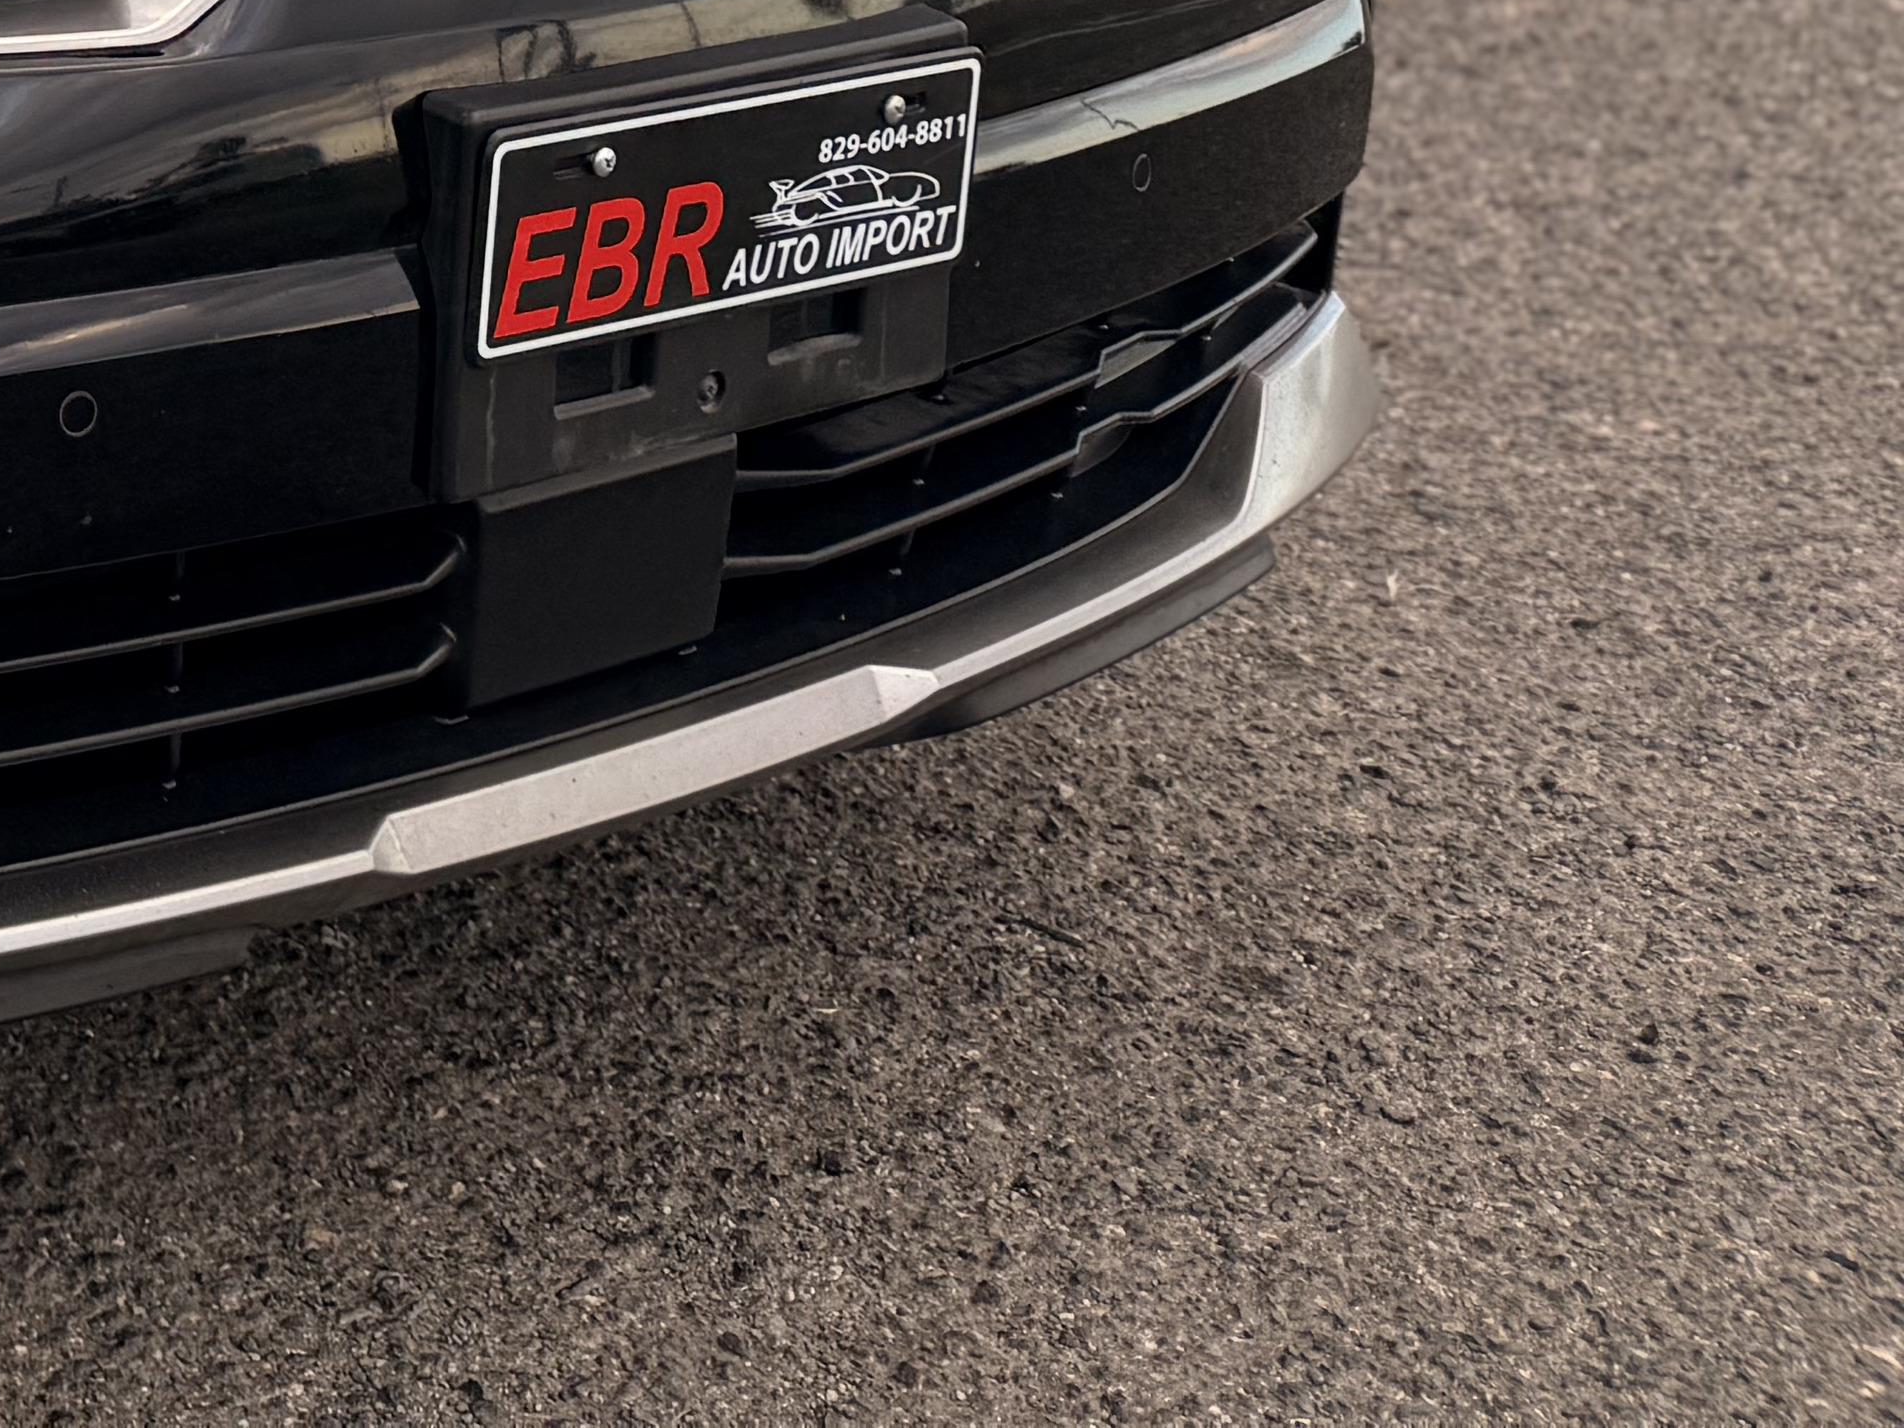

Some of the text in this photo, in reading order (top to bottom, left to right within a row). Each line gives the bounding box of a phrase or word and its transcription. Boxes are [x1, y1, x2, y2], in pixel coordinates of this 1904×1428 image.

[819, 113, 967, 163] 829-604-8811
[493, 181, 724, 338] EBR
[723, 205, 956, 290] AUTO IMPORT
